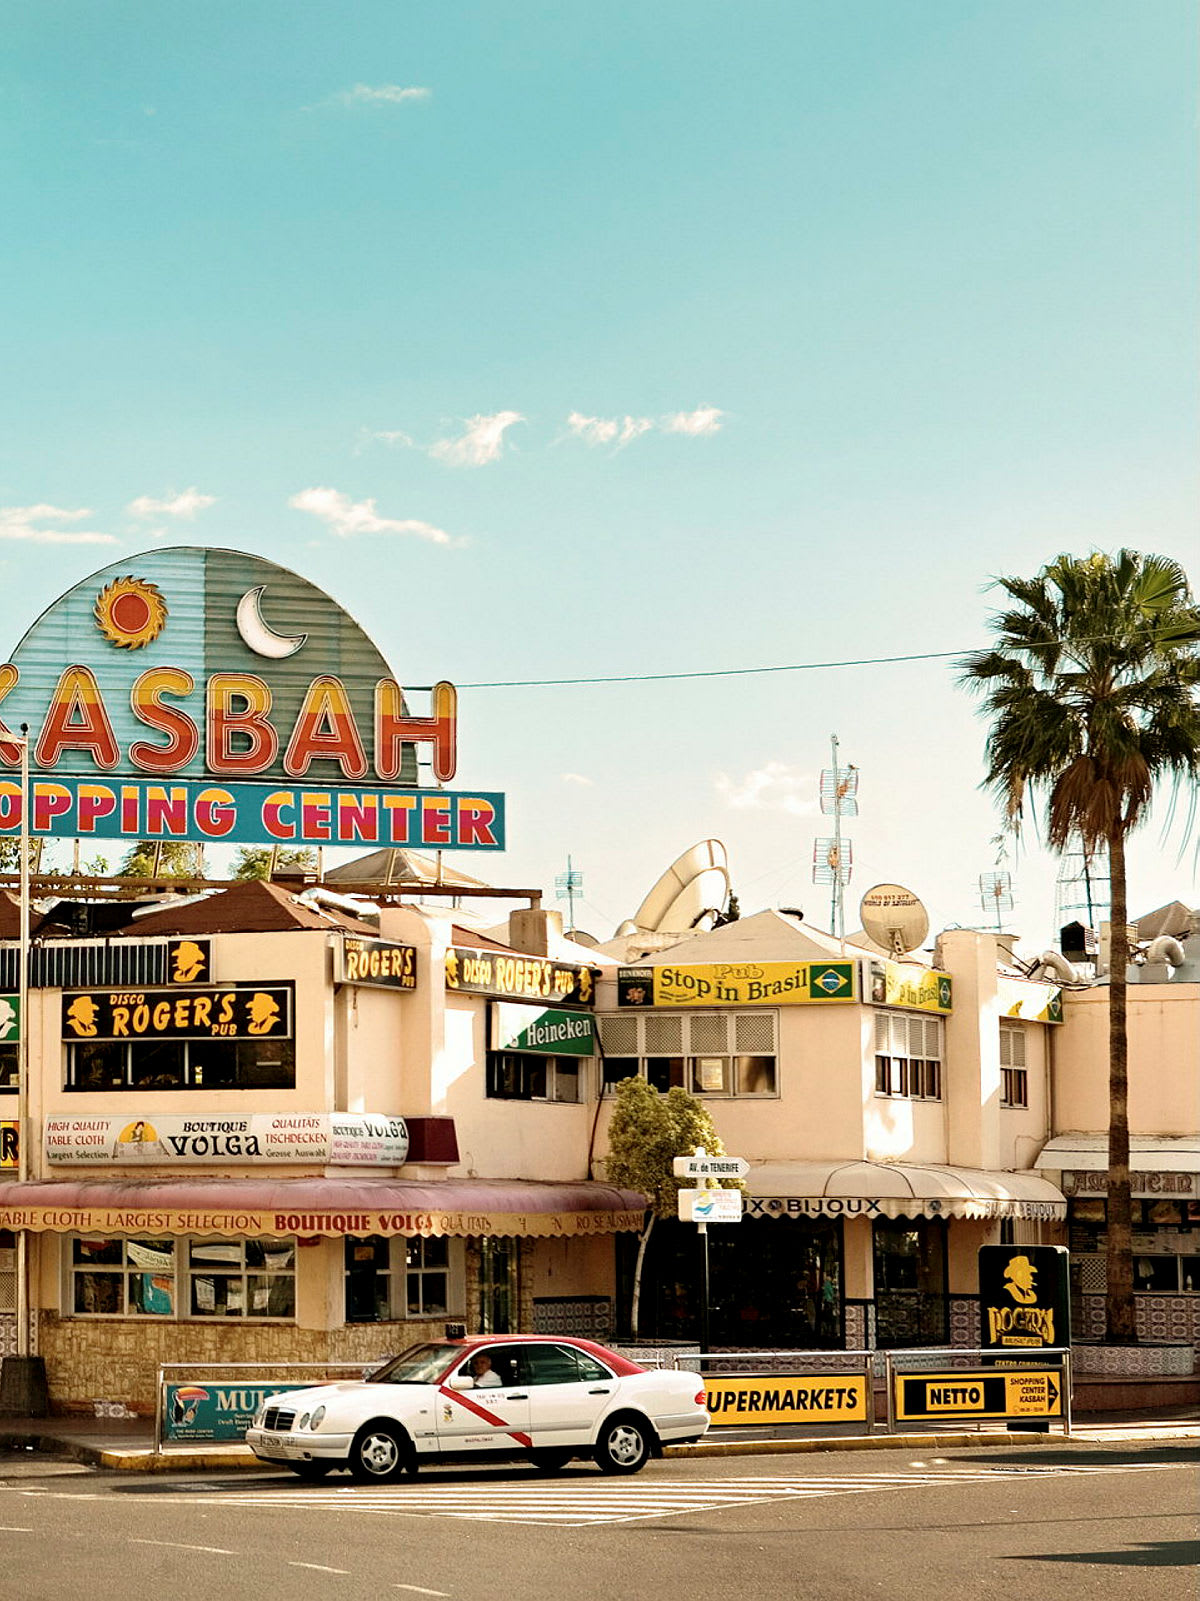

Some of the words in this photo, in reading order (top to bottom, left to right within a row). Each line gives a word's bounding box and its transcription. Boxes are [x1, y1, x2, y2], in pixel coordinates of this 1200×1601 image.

[261, 792, 498, 846] CENTER
[347, 947, 414, 980] ROGER'S
[463, 957, 491, 985] DISCO
[495, 957, 552, 997] ROGER'S
[554, 970, 575, 993] PUB
[712, 964, 764, 980] Pub
[402, 975, 415, 987] PUB
[660, 968, 712, 999] Stop
[715, 981, 740, 1001] in
[747, 968, 808, 1001] Brasil
[109, 993, 145, 1005] DISCO
[112, 993, 236, 1036] ROGER'S
[211, 1024, 237, 1036] PUB
[526, 1018, 591, 1047] Heineken
[47, 1121, 70, 1132] HIGH
[72, 1120, 111, 1132] QUALITY
[183, 1121, 248, 1133] BOUTIQUE
[47, 1135, 72, 1146] TABLE
[75, 1134, 105, 1146] CLOTH
[265, 1132, 328, 1145] TISCHDECKEN
[46, 1150, 73, 1160] Largest
[76, 1150, 109, 1160] Selection
[710, 1162, 739, 1172] TENERIFE
[786, 1199, 882, 1213] BIJOUX
[42, 1211, 92, 1226] CLOTH
[106, 1212, 173, 1228] LARGEST
[177, 1213, 262, 1230] SELECTION
[275, 1213, 371, 1233] BOUTIQUE
[1010, 1377, 1045, 1386] SHOPPING
[930, 1387, 981, 1405] NETTO
[1021, 1386, 1045, 1395] CENTER
[215, 1390, 283, 1412] MUL
[707, 1388, 858, 1413] UPERMARKETS
[1019, 1395, 1046, 1403] KASBAH
